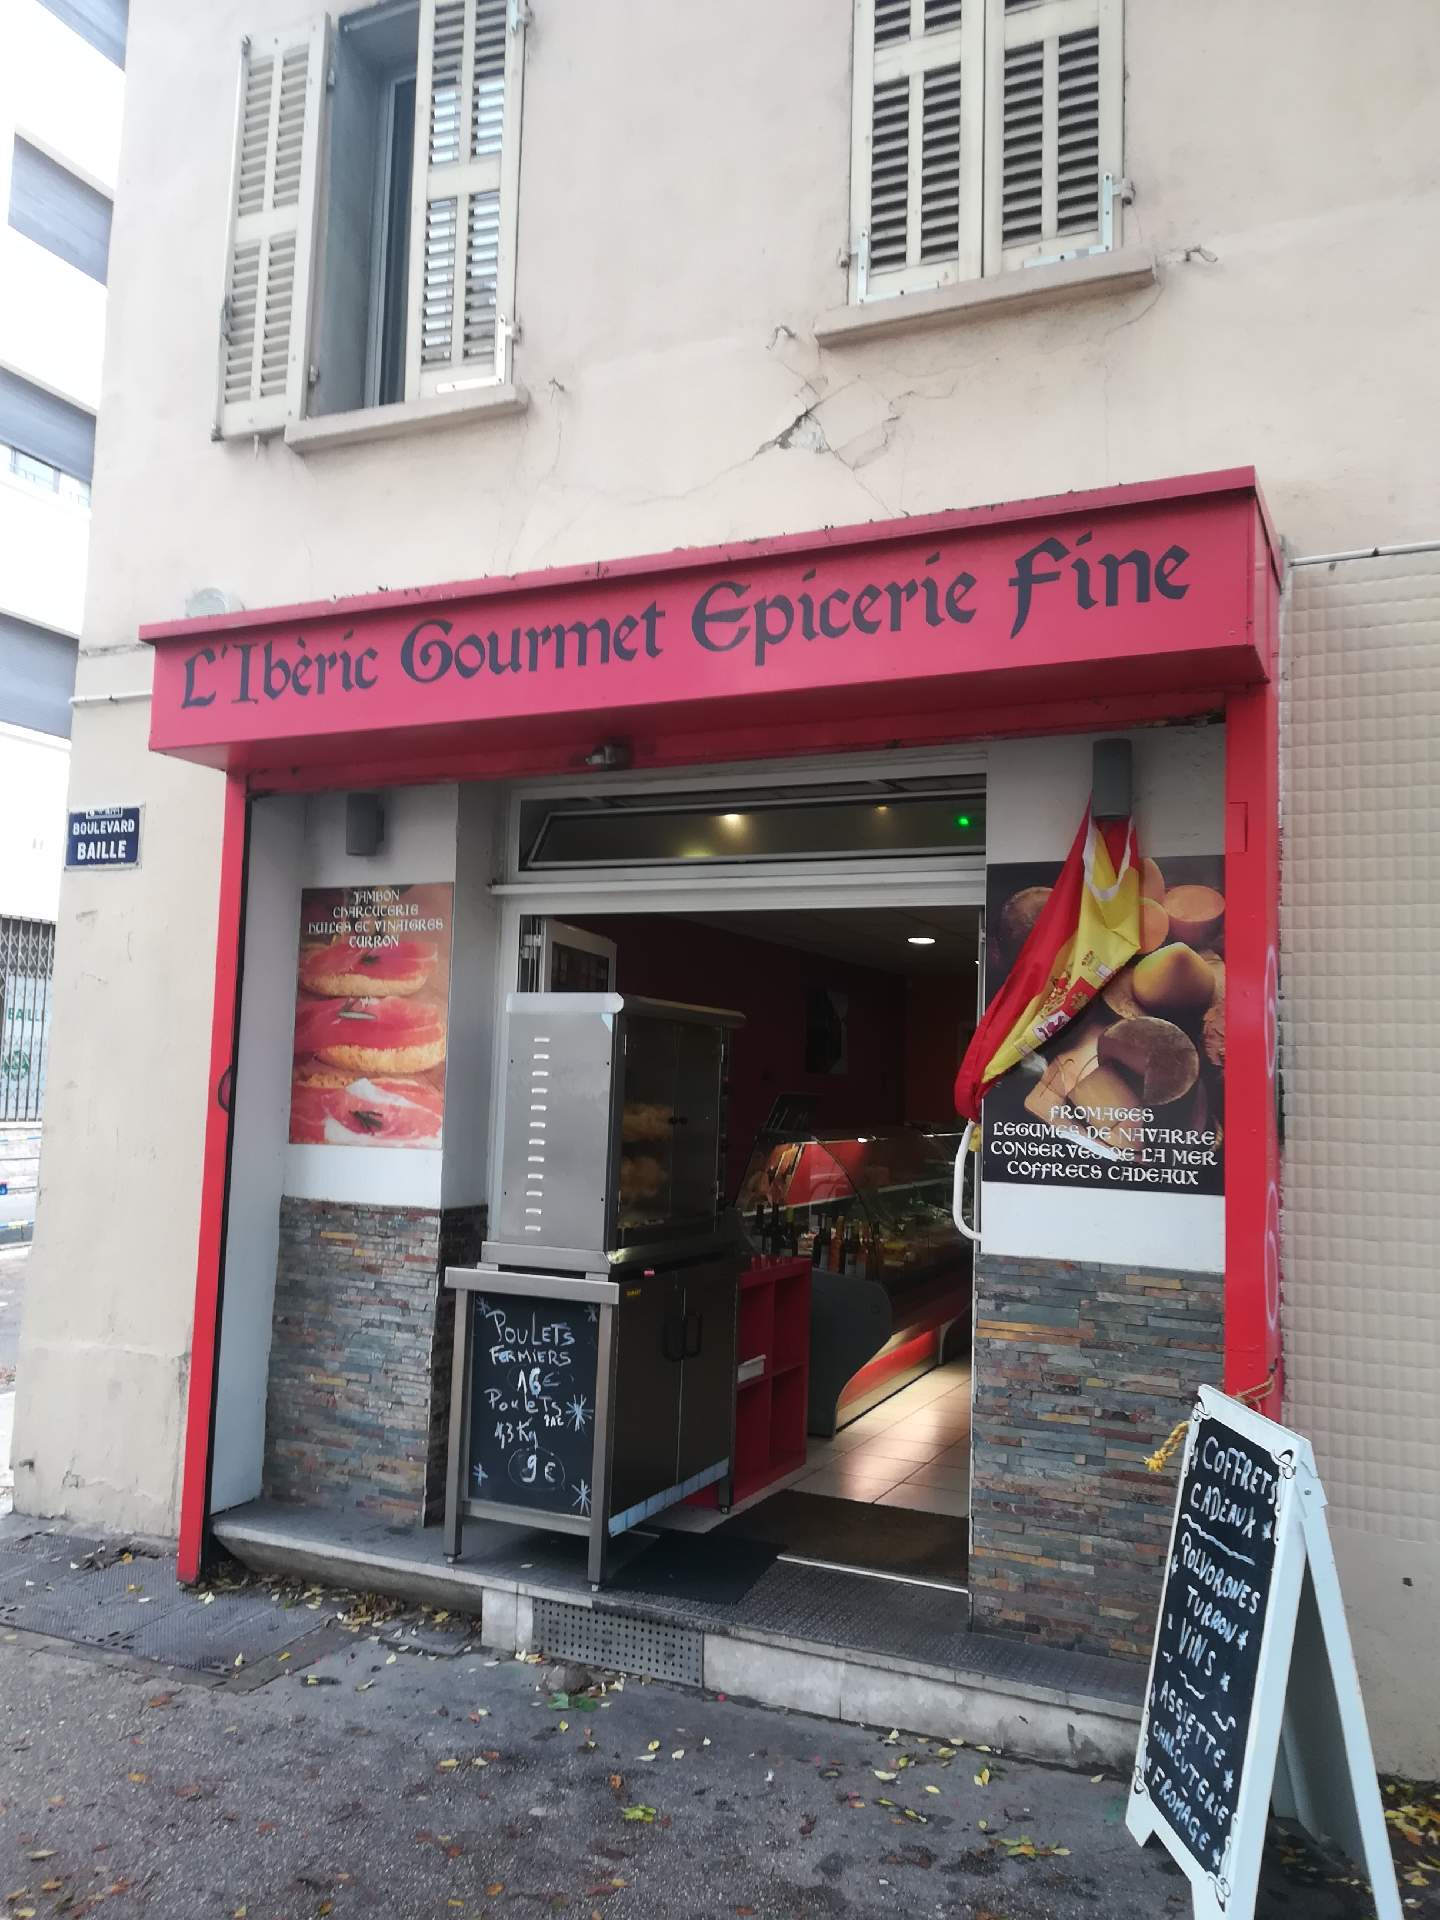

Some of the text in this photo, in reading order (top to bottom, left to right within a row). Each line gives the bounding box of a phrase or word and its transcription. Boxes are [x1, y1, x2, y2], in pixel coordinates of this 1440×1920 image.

[400, 599, 666, 684] Gourmet
[691, 552, 978, 667] Epicerie
[1007, 530, 1191, 640] Fine
[72, 818, 135, 836] BOULEVARD
[77, 840, 127, 860] BAILLE
[354, 890, 400, 904] JAMBON
[354, 921, 370, 933] ET
[375, 918, 444, 933] VINAIGRES
[1049, 1105, 1154, 1123] FROMAGES
[1086, 1125, 1112, 1140] DE
[1119, 1127, 1216, 1146] NAVARRE
[1141, 1148, 1166, 1163] LA
[1172, 1150, 1218, 1166] MER
[1007, 1160, 1199, 1186] COFFRETS CADEAUX
[1202, 1435, 1279, 1505] COFFRETS
[1181, 1531, 1261, 1615] POLVORONES
[1150, 1765, 1211, 1851] FROMAGE
